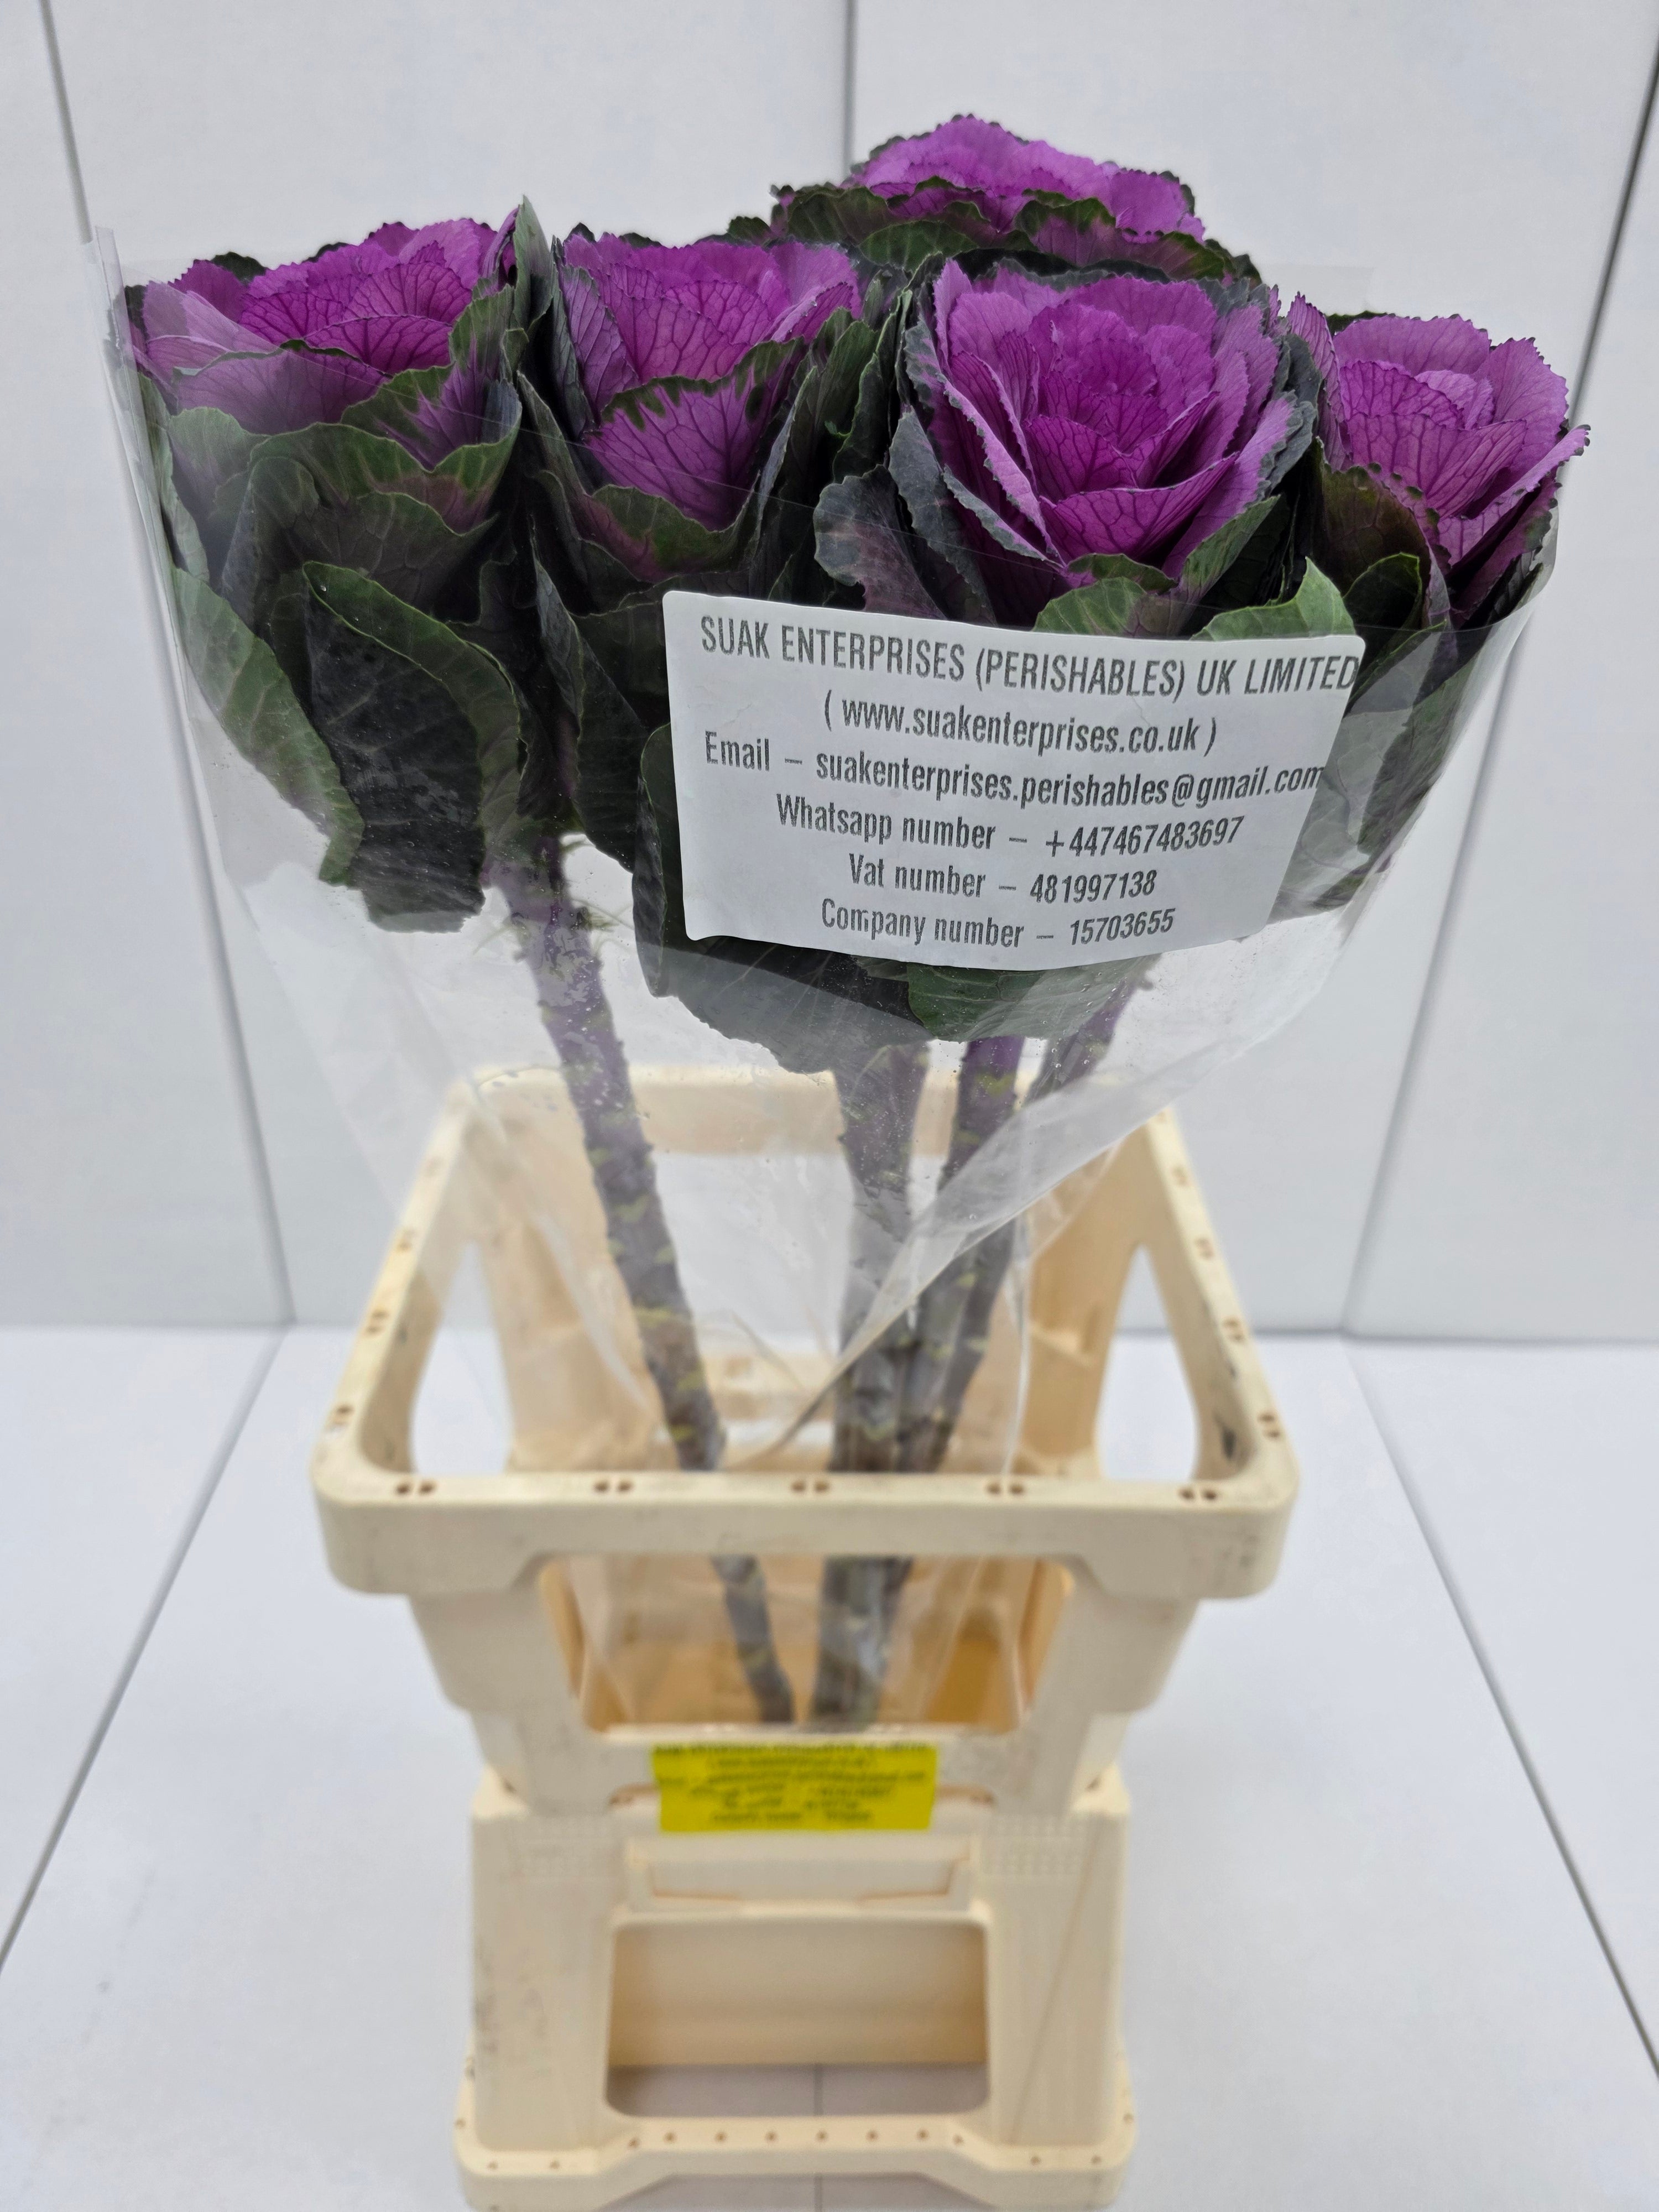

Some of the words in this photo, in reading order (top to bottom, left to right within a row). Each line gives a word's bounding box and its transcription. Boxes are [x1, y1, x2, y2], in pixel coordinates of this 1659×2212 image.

[701, 616, 770, 659] SUAK
[782, 625, 965, 682] ENTERPRISES
[976, 648, 1185, 703] (PERISHABLES)
[1197, 660, 1238, 696] UK
[1244, 656, 1360, 695] LIMITED
[842, 700, 1200, 757] www.suakenterprises.co.uk
[705, 731, 770, 771] Email
[816, 750, 1324, 810] suakenterprises.perishables@gmail.com
[776, 794, 892, 845] Whatsapp
[902, 816, 996, 849] number
[1045, 815, 1245, 857] +447467483697
[848, 853, 885, 888] Vat
[895, 864, 986, 898] number
[1030, 869, 1157, 904] 481997138
[822, 898, 926, 946] Company
[934, 916, 1025, 948] number
[1070, 907, 1176, 946] 15703655
